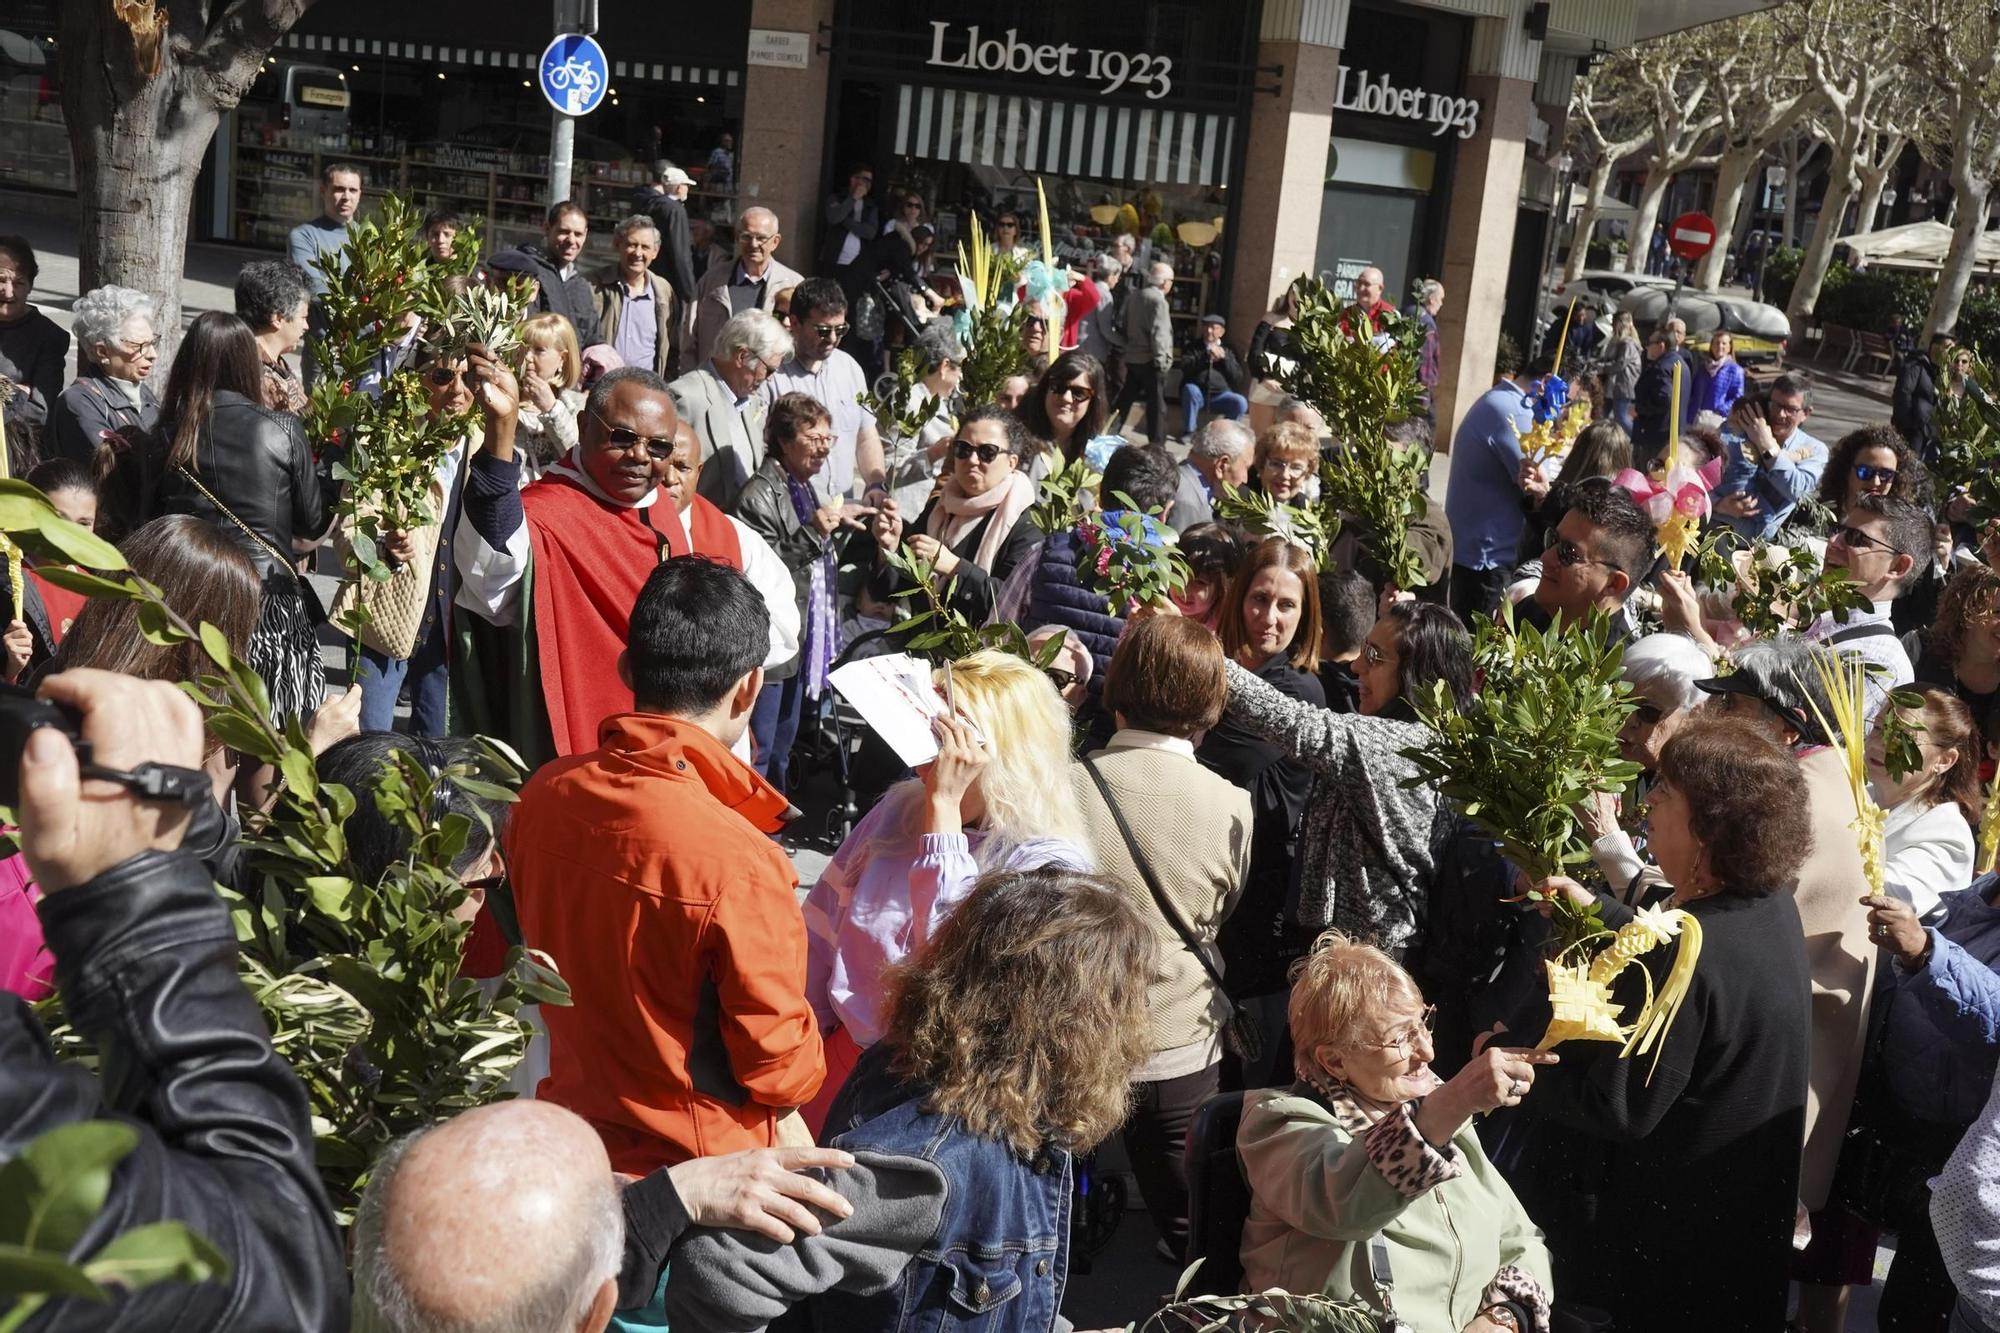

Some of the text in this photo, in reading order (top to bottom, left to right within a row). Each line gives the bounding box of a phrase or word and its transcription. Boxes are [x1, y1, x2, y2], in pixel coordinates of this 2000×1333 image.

[926, 21, 1172, 99] Llobet 1923
[1333, 65, 1479, 139] Llobet 1923
